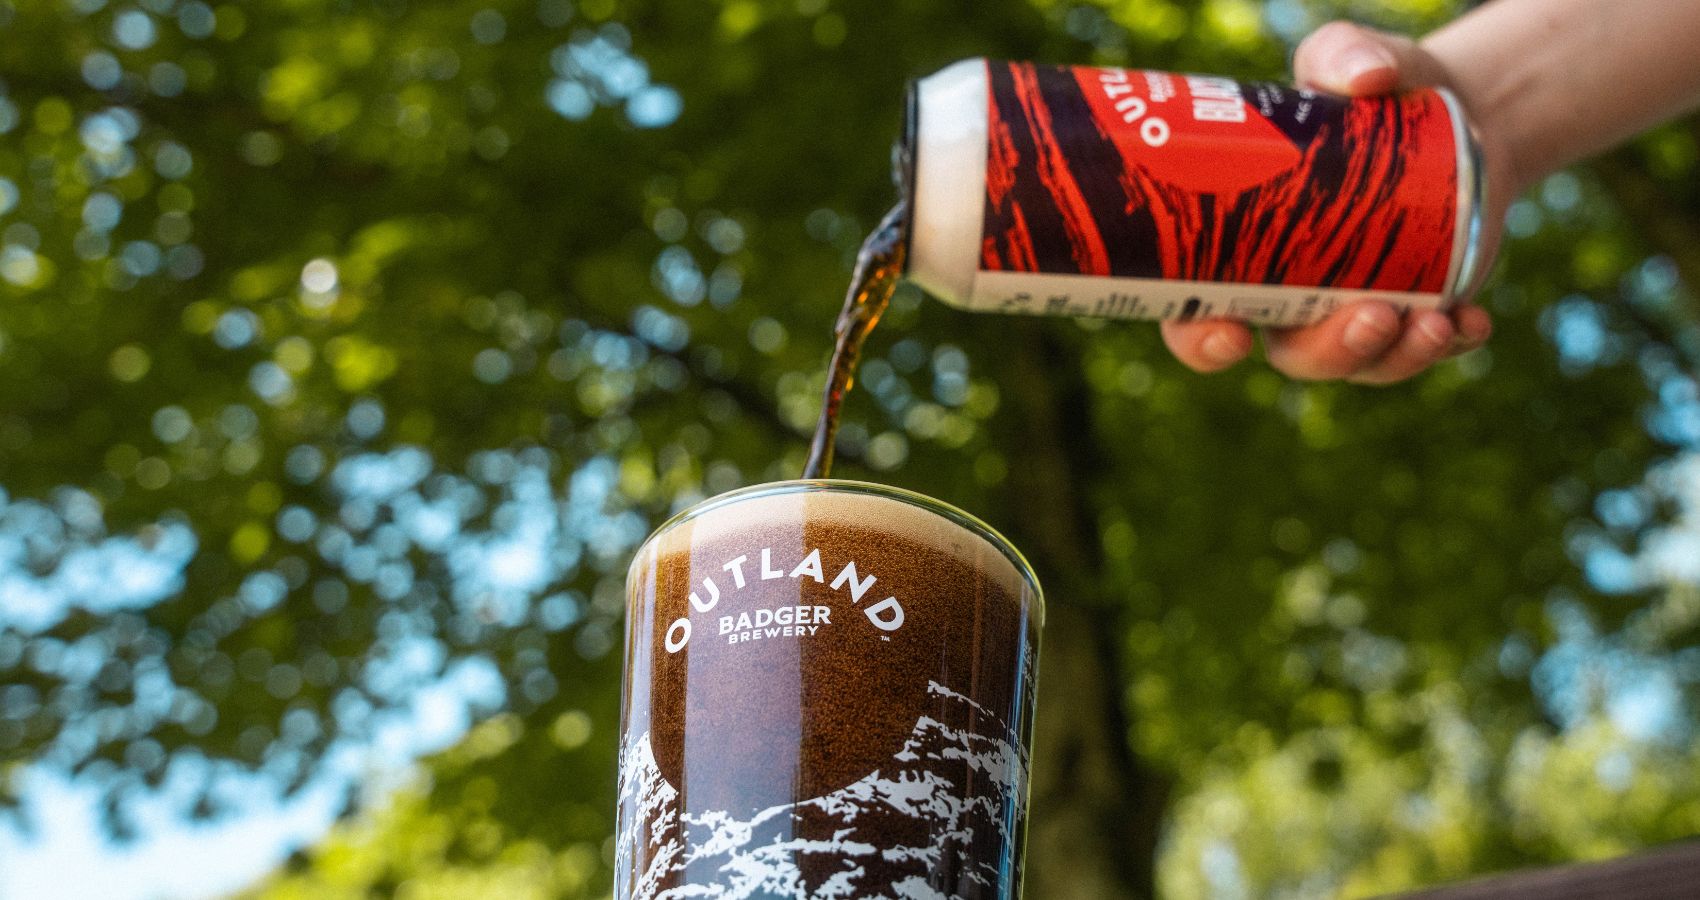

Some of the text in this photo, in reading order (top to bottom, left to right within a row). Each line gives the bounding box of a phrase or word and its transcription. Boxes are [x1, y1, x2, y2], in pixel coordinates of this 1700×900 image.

[665, 548, 905, 654] OUTLAND
[719, 605, 832, 636] BADGER
[728, 625, 819, 645] BREWERY
